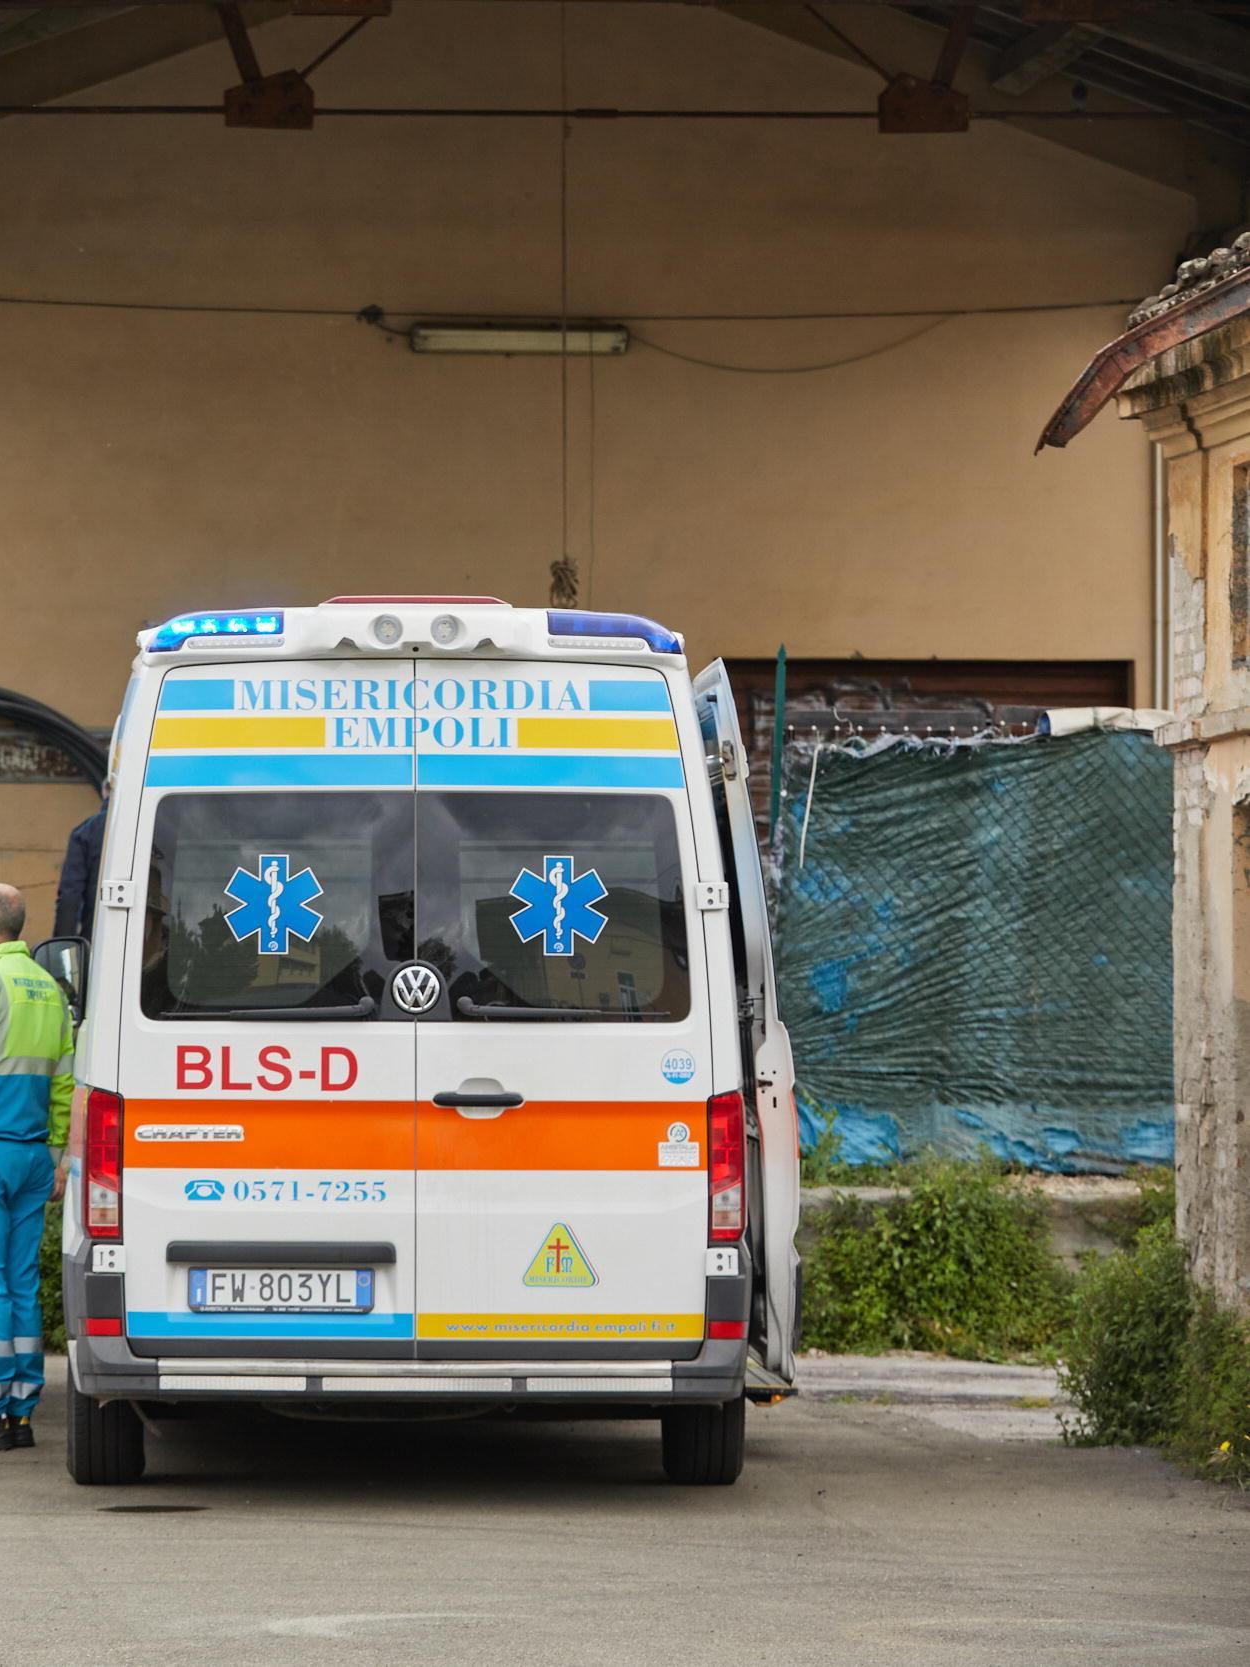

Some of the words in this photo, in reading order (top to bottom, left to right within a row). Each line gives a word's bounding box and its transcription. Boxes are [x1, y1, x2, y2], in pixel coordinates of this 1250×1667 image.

[238, 679, 585, 711] MISERICORDIA
[333, 716, 512, 748] EMPOLI
[176, 1045, 359, 1091] BLS-D
[664, 1058, 692, 1070] 4039
[137, 1126, 243, 1139] CRAFTER
[233, 1180, 387, 1202] 0571-7255
[211, 1273, 247, 1303] FW
[259, 1273, 352, 1303] 803YL
